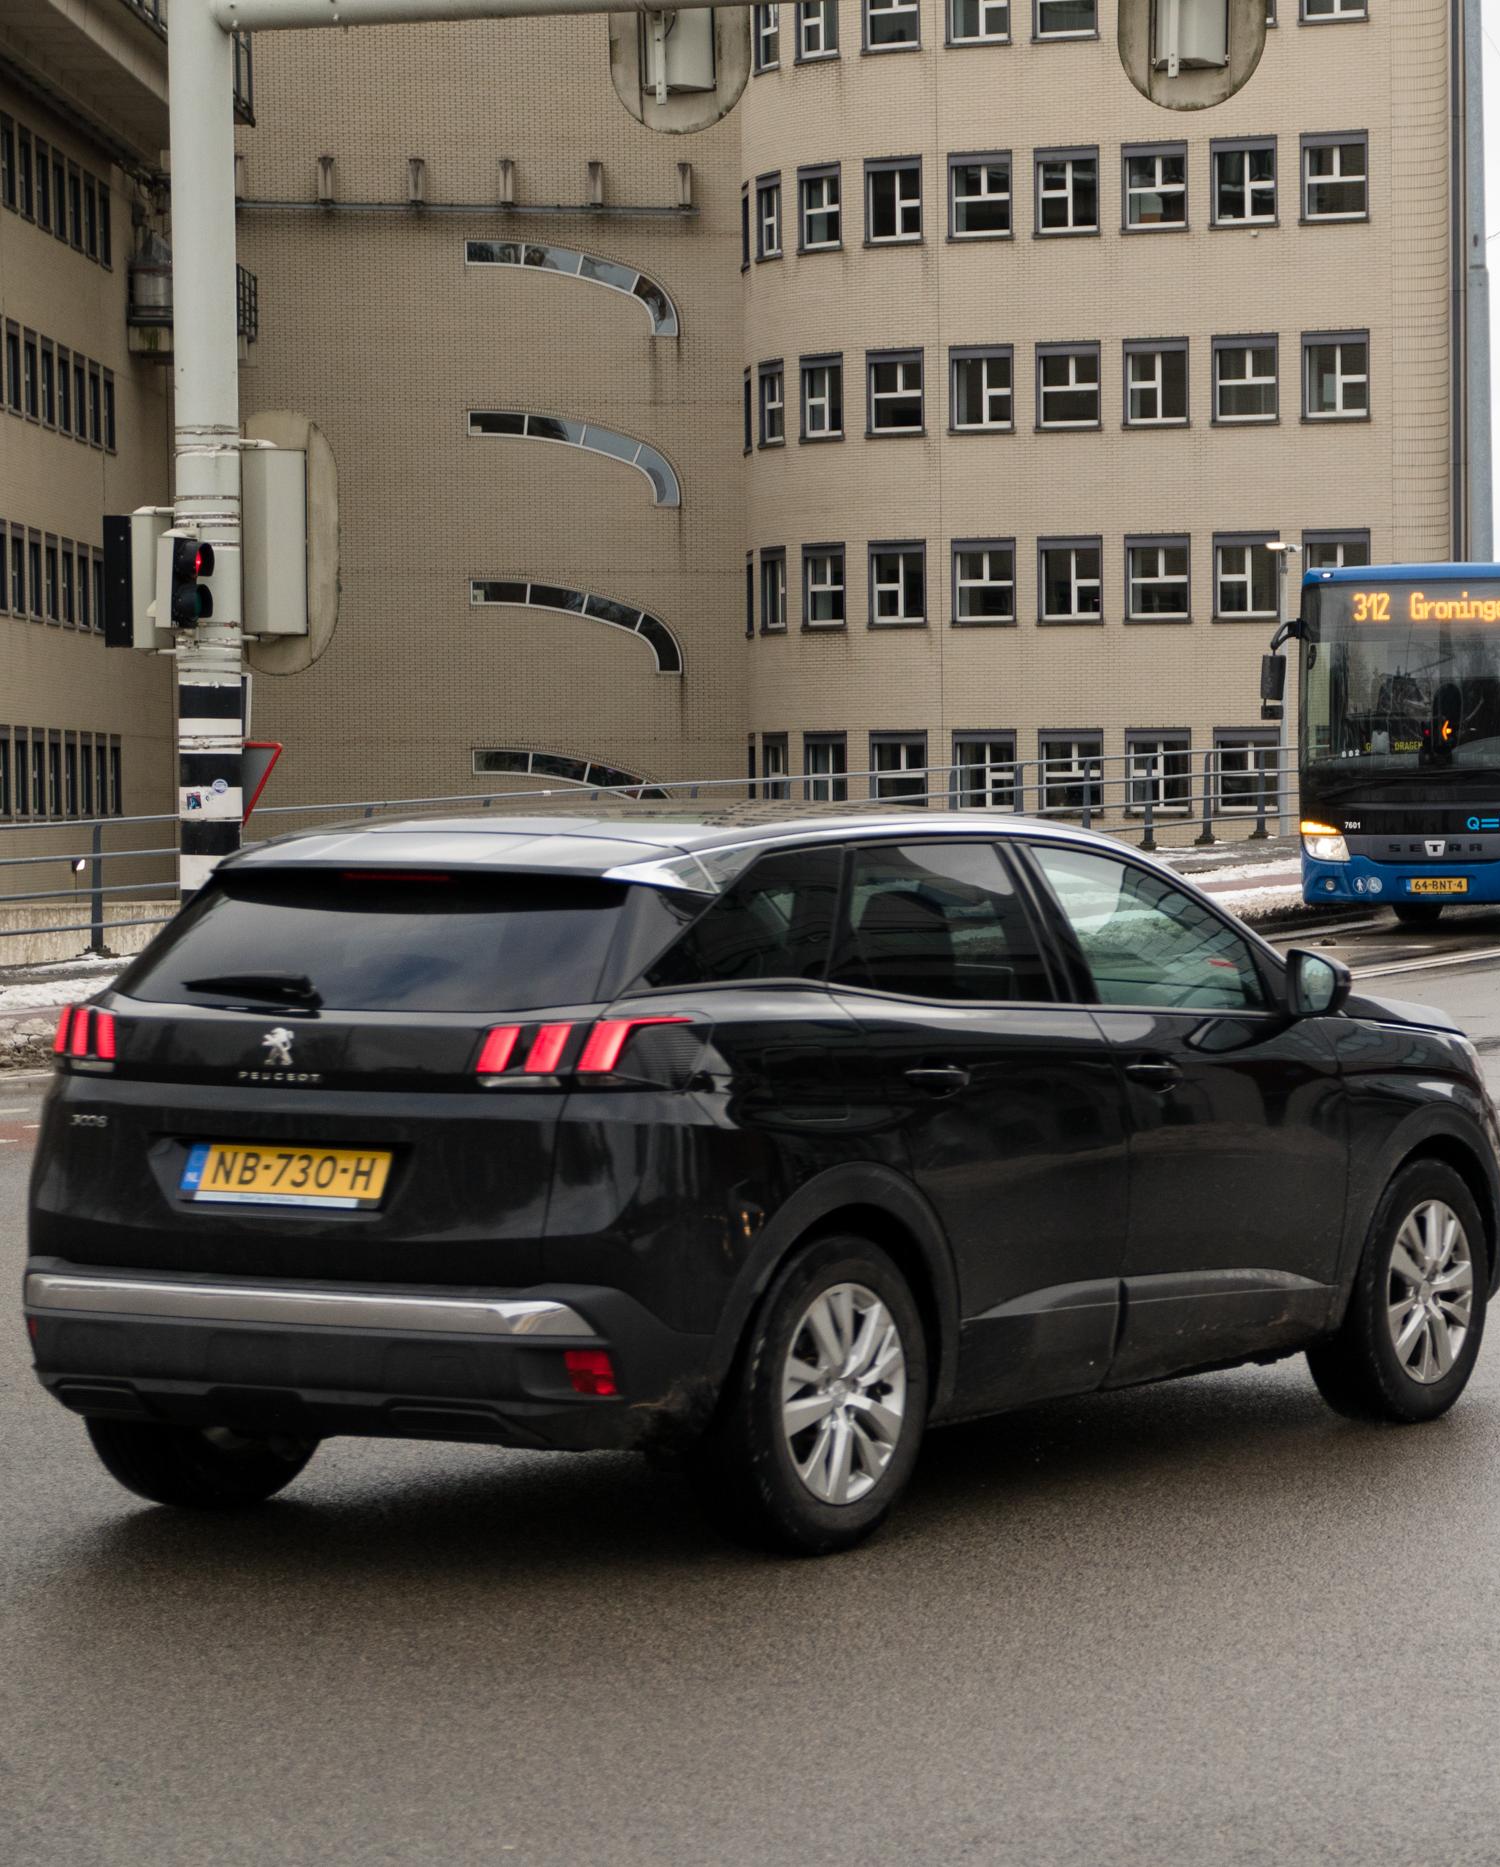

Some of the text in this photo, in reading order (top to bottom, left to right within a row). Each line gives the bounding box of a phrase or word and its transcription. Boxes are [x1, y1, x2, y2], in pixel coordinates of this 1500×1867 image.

[1353, 592, 1391, 621] 312
[1344, 821, 1361, 829] 7601
[1388, 843, 1483, 853] SETRA
[1414, 880, 1463, 890] 64-BNT-4
[211, 1150, 377, 1192] NB-730-H
